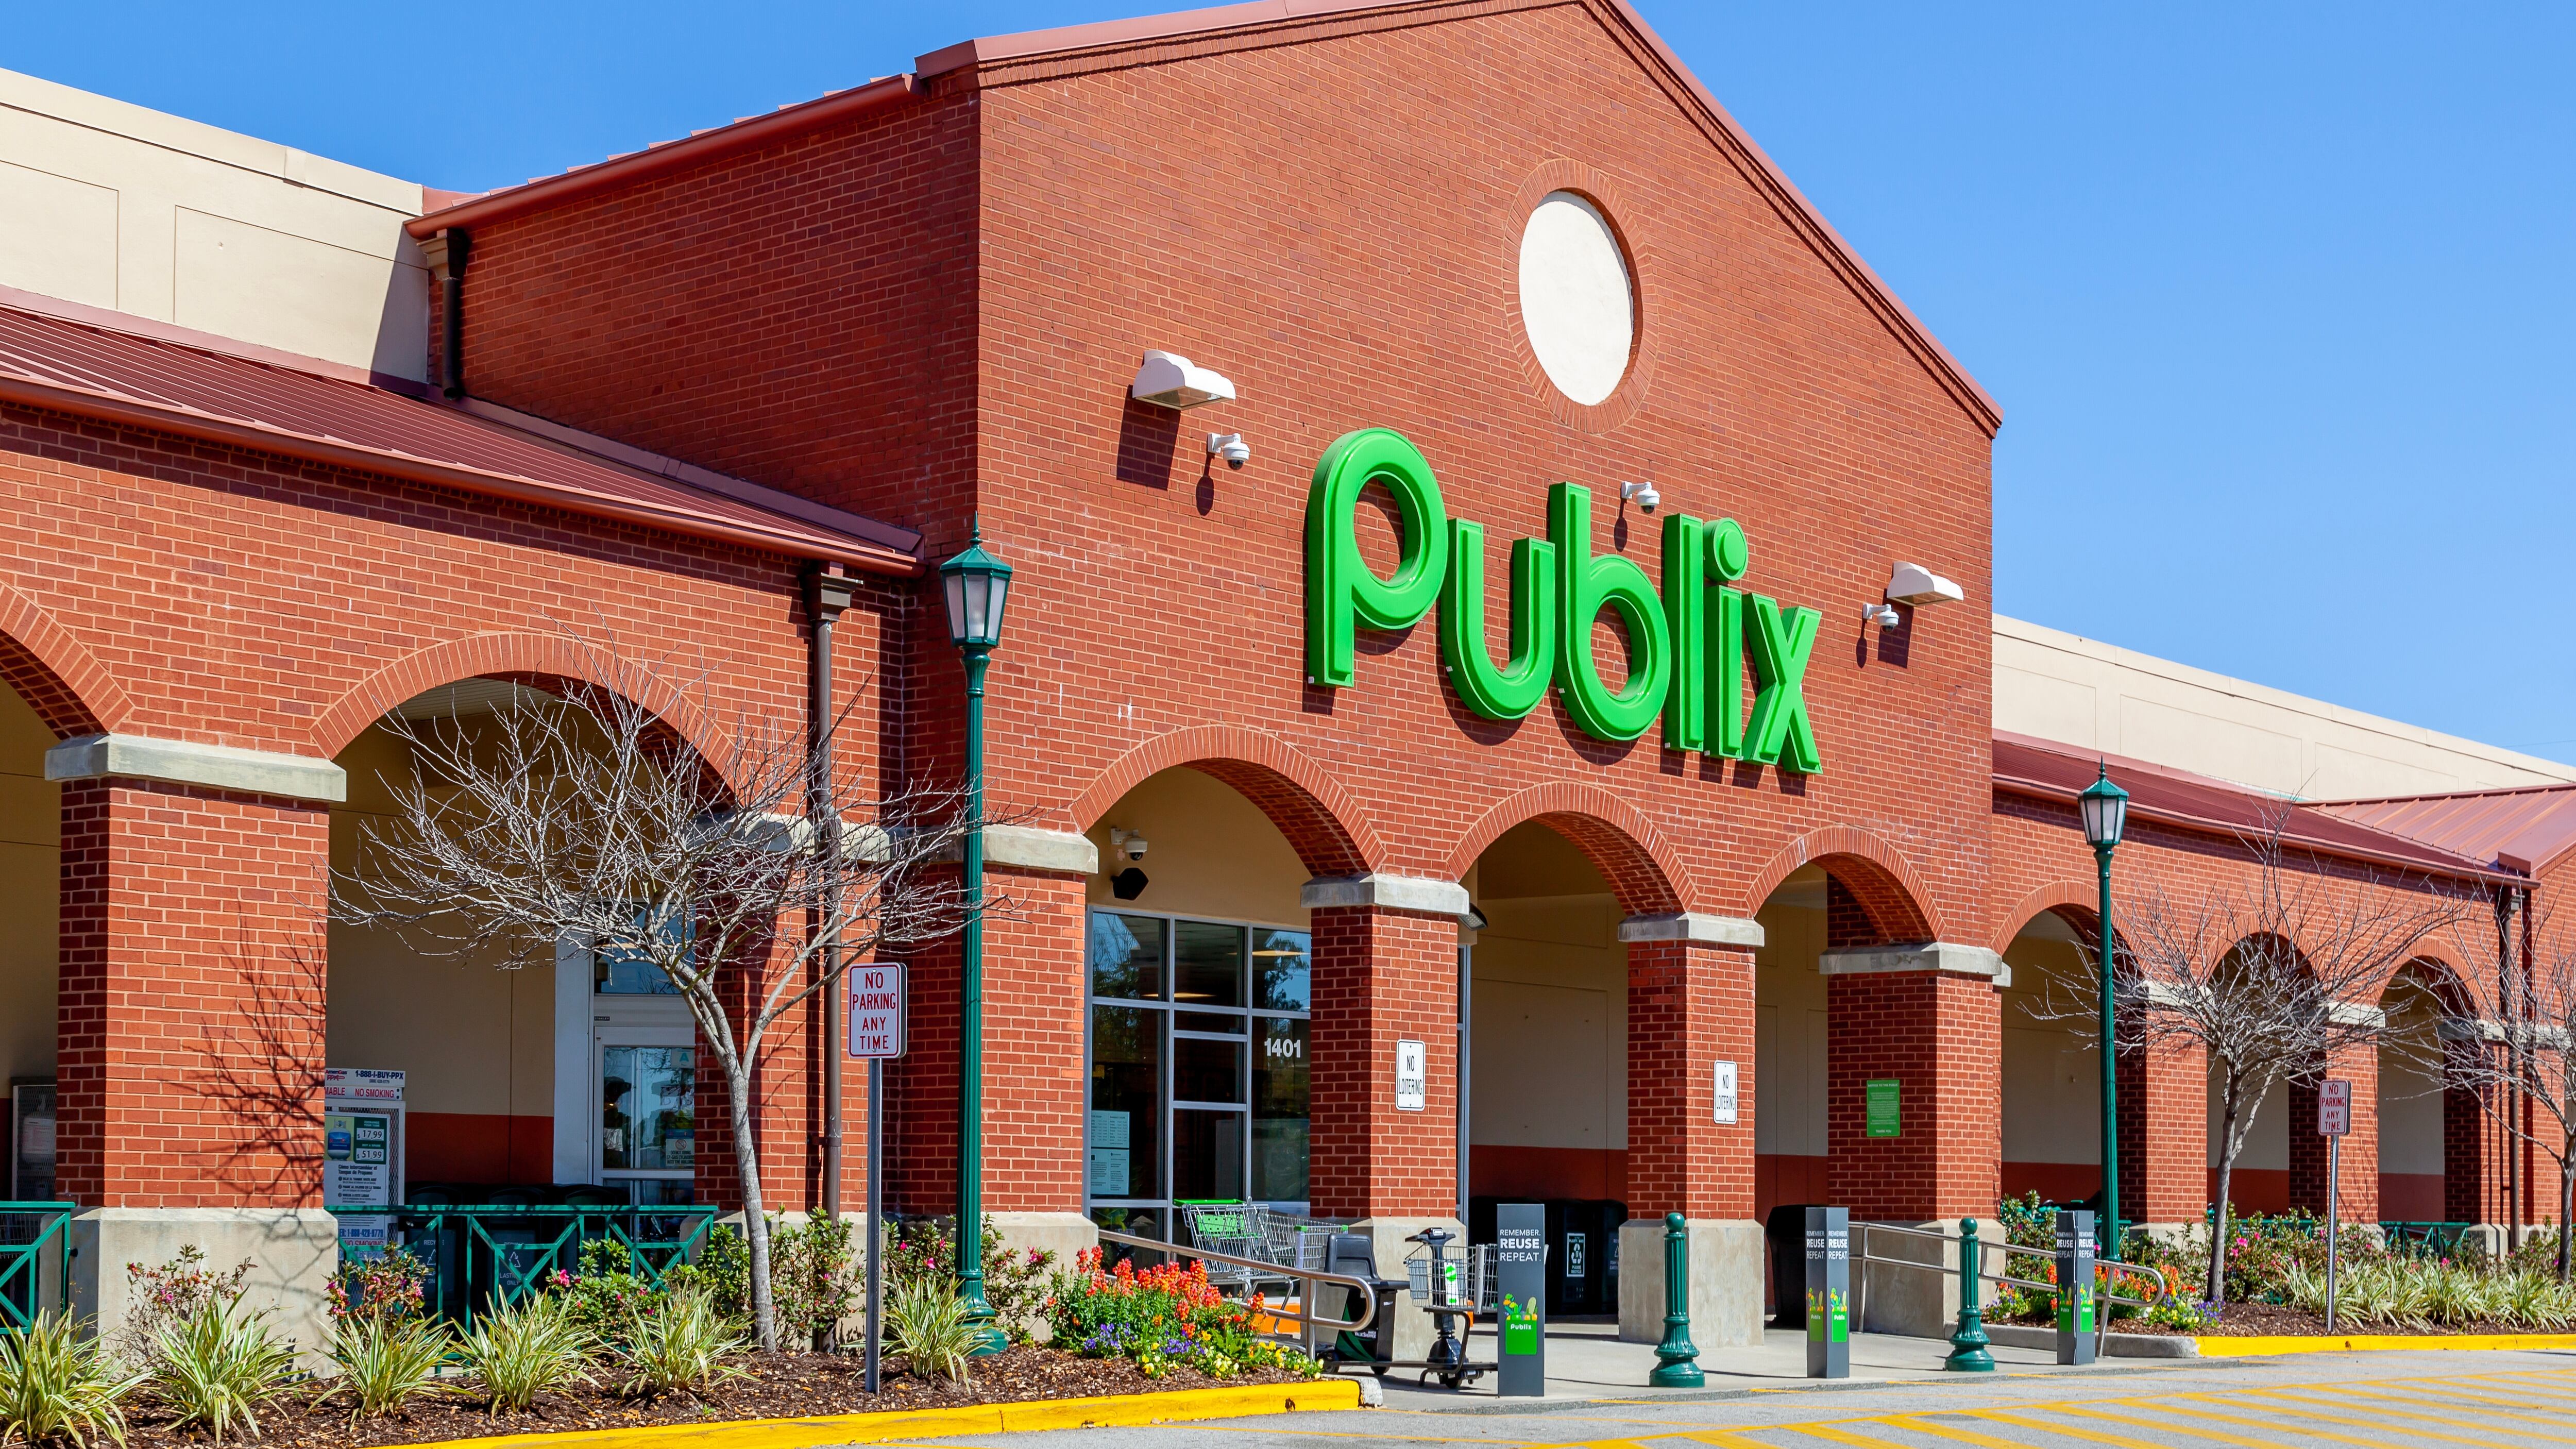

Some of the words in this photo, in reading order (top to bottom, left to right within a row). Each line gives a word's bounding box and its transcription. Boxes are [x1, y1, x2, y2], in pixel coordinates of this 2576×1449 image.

[1307, 427, 1823, 774] Publix
[866, 972, 884, 989] NO
[853, 992, 896, 1010] PARKING
[862, 1017, 886, 1031] ANY
[860, 1035, 889, 1050] TIME
[1264, 1038, 1301, 1058] 1401
[1406, 1055, 1415, 1072] NO
[355, 1070, 404, 1080] 1-888-I-BUY-PPX
[1399, 1078, 1422, 1095] LOITERING
[1722, 1074, 1729, 1089] NO
[325, 1087, 346, 1096] MABLE
[355, 1088, 364, 1097] NO
[366, 1089, 394, 1098] SMOKING
[2329, 1085, 2338, 1094] NO
[1717, 1095, 1735, 1110] LOITERING
[2321, 1097, 2345, 1107] PARKING
[2326, 1110, 2339, 1119] ANY
[2325, 1121, 2340, 1130] TIME
[363, 1130, 382, 1139] 17.99
[362, 1150, 382, 1159] 51.99
[1500, 1238, 1541, 1249] REUSE.
[1500, 1252, 1541, 1261] REPEAT.
